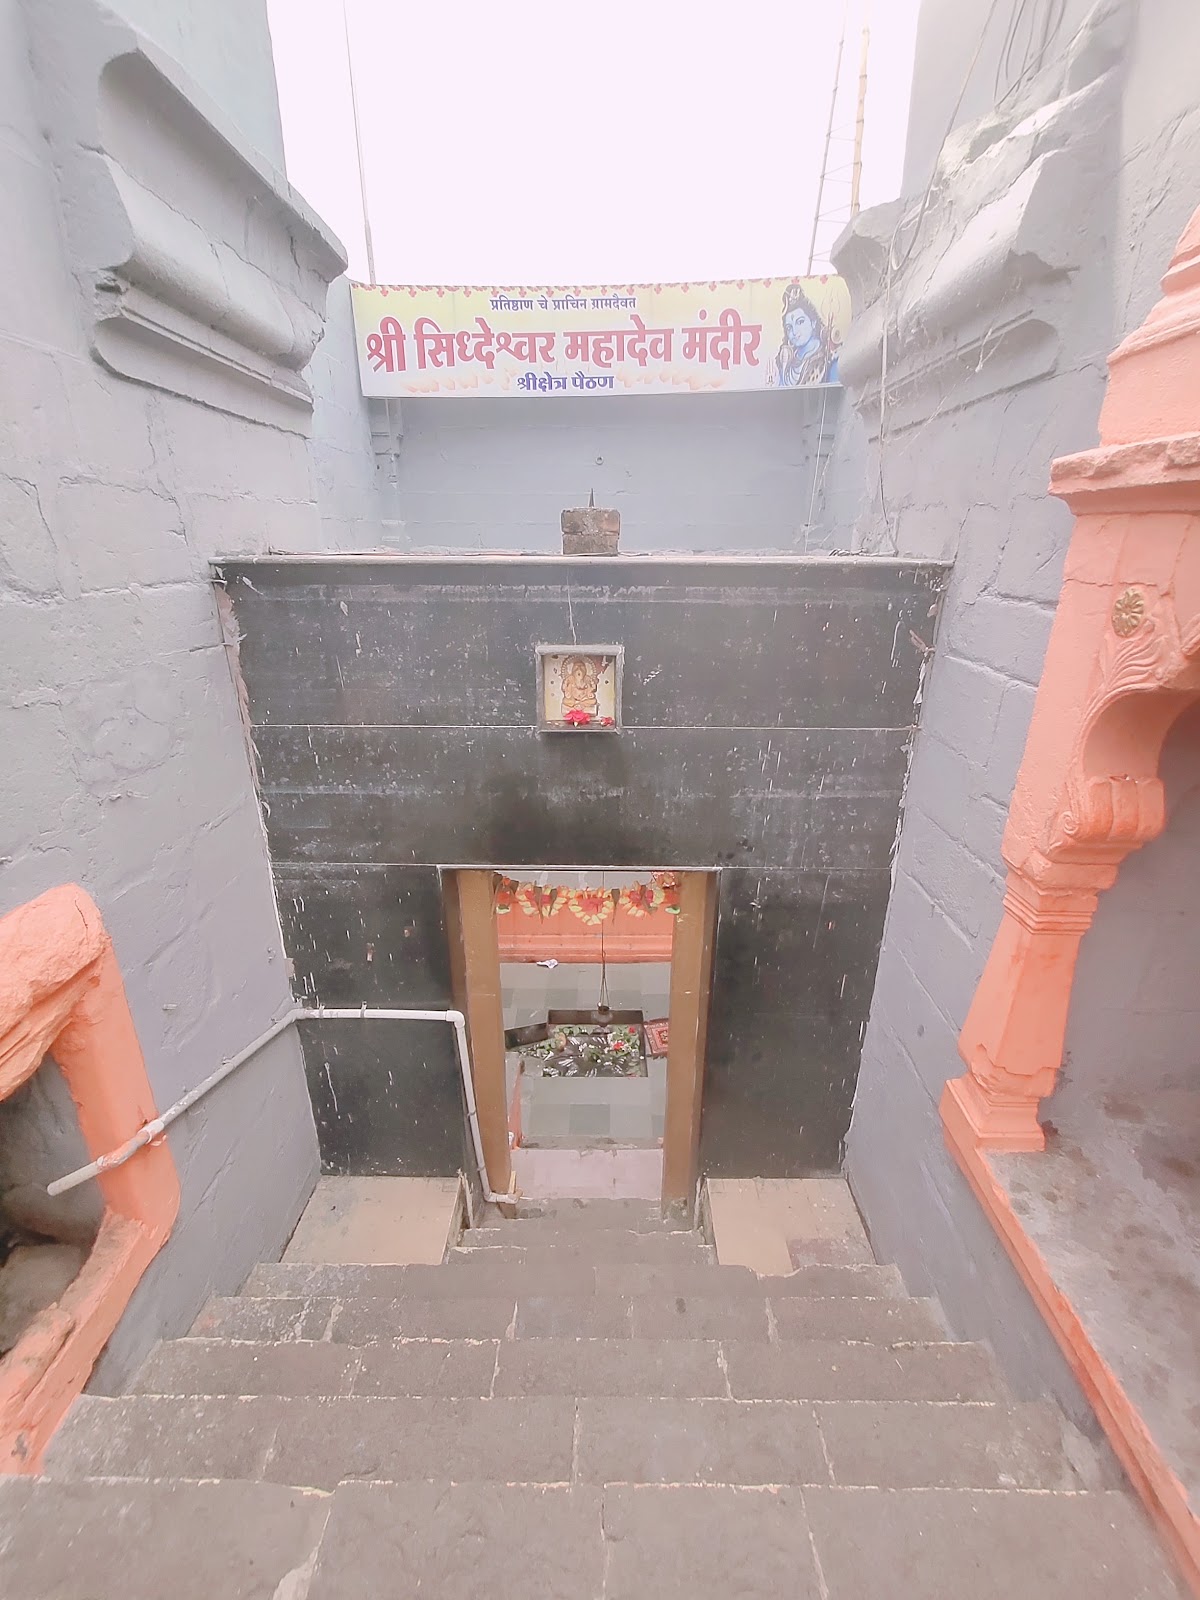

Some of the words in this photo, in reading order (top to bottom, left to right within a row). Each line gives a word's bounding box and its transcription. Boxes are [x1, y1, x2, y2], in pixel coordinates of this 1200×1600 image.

[537, 295, 548, 310] चे
[552, 294, 587, 310] प्राचिन
[591, 293, 636, 310] ग्रामदैवत
[367, 316, 406, 372] श्री
[563, 314, 674, 368] महादेव
[682, 308, 762, 370] मंदीर
[517, 372, 567, 392] श्रीक्षेत्र
[571, 371, 614, 389] पैठण
